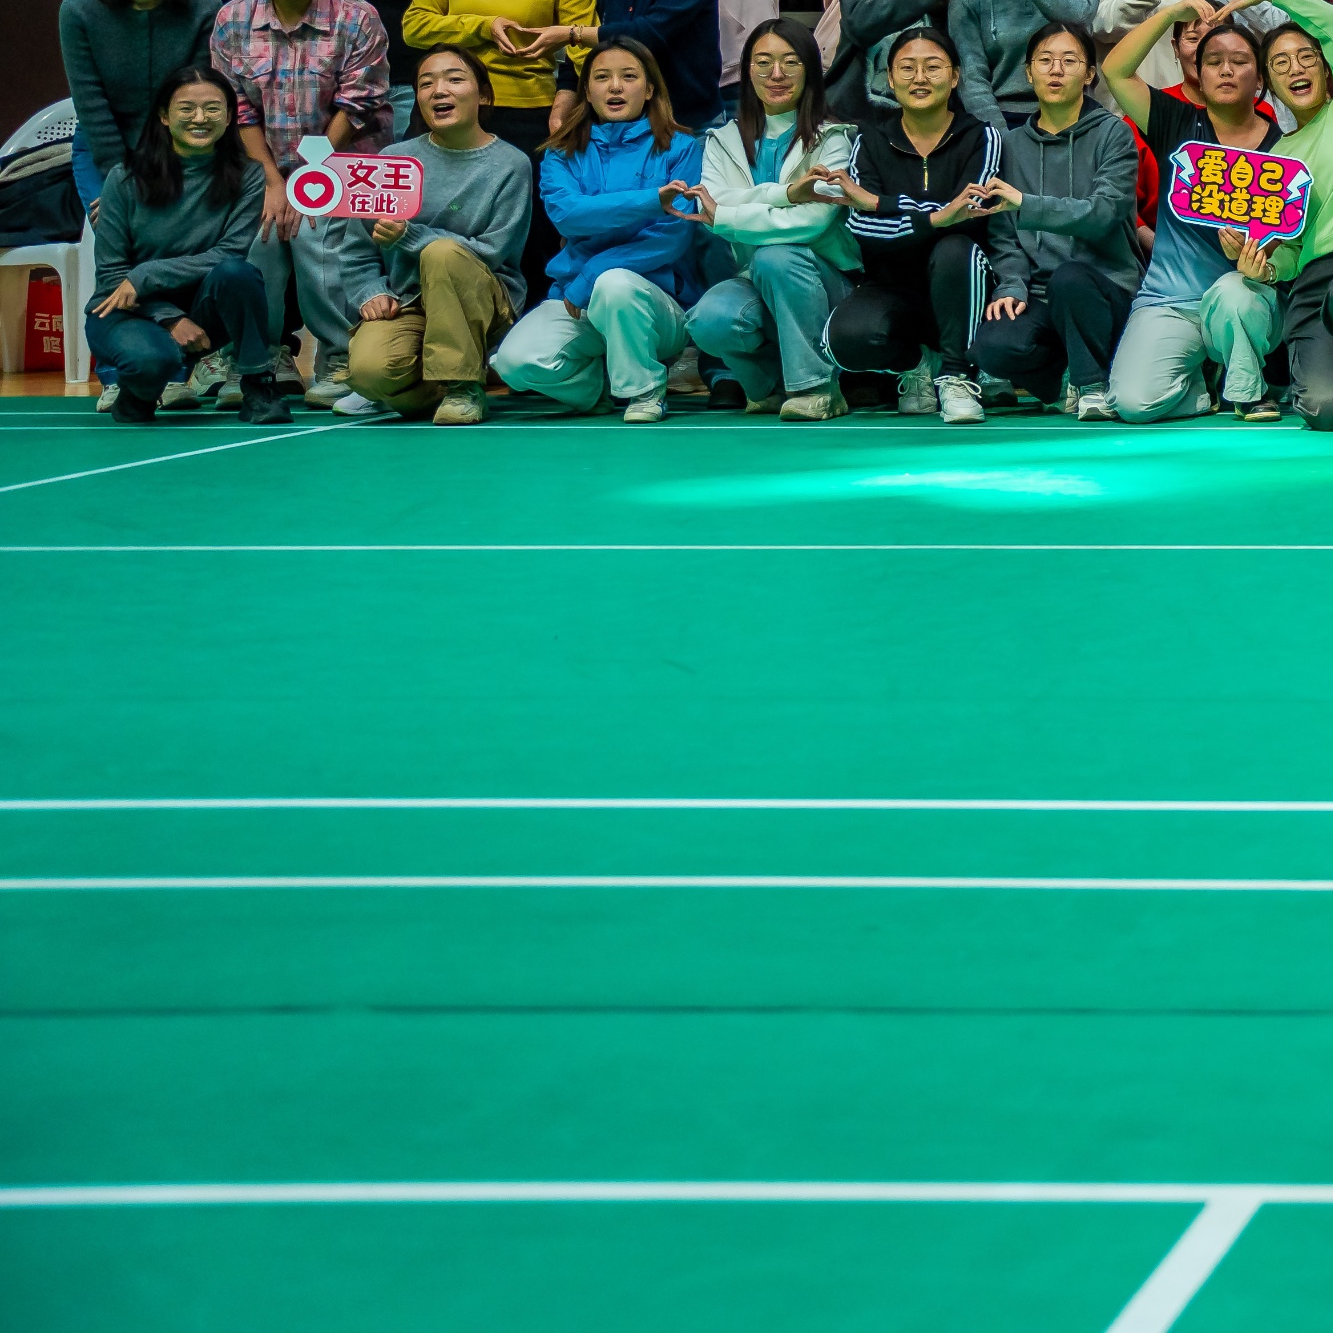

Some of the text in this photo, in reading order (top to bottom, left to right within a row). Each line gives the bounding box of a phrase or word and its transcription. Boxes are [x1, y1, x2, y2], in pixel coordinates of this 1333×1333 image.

[347, 160, 413, 191] 女王
[1198, 149, 1285, 192] 爱自己
[349, 192, 399, 214] 在此
[1191, 183, 1286, 226] 没道理
